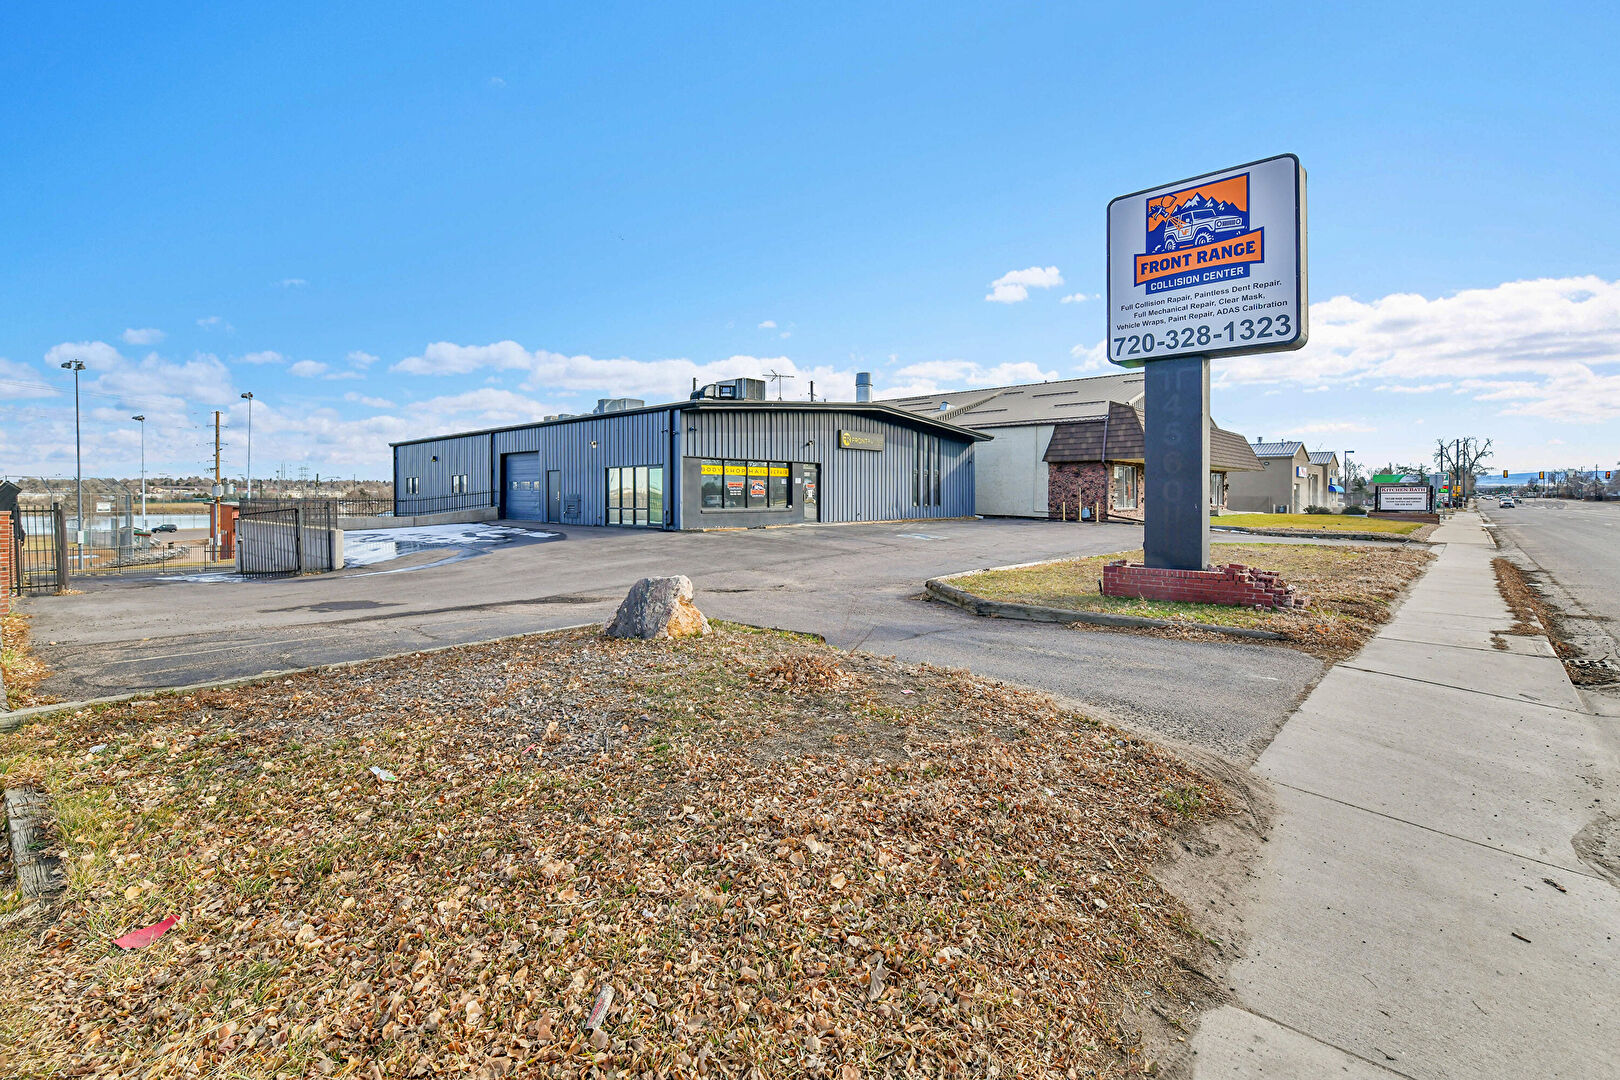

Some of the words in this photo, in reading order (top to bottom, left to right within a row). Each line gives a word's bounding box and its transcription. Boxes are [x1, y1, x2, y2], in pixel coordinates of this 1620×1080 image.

[1140, 254, 1192, 275] FRONT
[1197, 240, 1256, 264] RANGE
[1150, 274, 1200, 290] COLLISION
[1203, 266, 1244, 281] CENTER
[1134, 299, 1166, 308] Collision
[1194, 288, 1230, 299] Paintless
[1232, 284, 1250, 292] Dent
[1148, 304, 1188, 316] Mechanical
[1218, 297, 1240, 305] Clear
[1116, 322, 1140, 330] Vehicle
[1168, 314, 1186, 322] Paint
[1216, 306, 1240, 316] ADAS
[1242, 300, 1288, 312] Calibration
[1114, 314, 1292, 356] 720-328-1323
